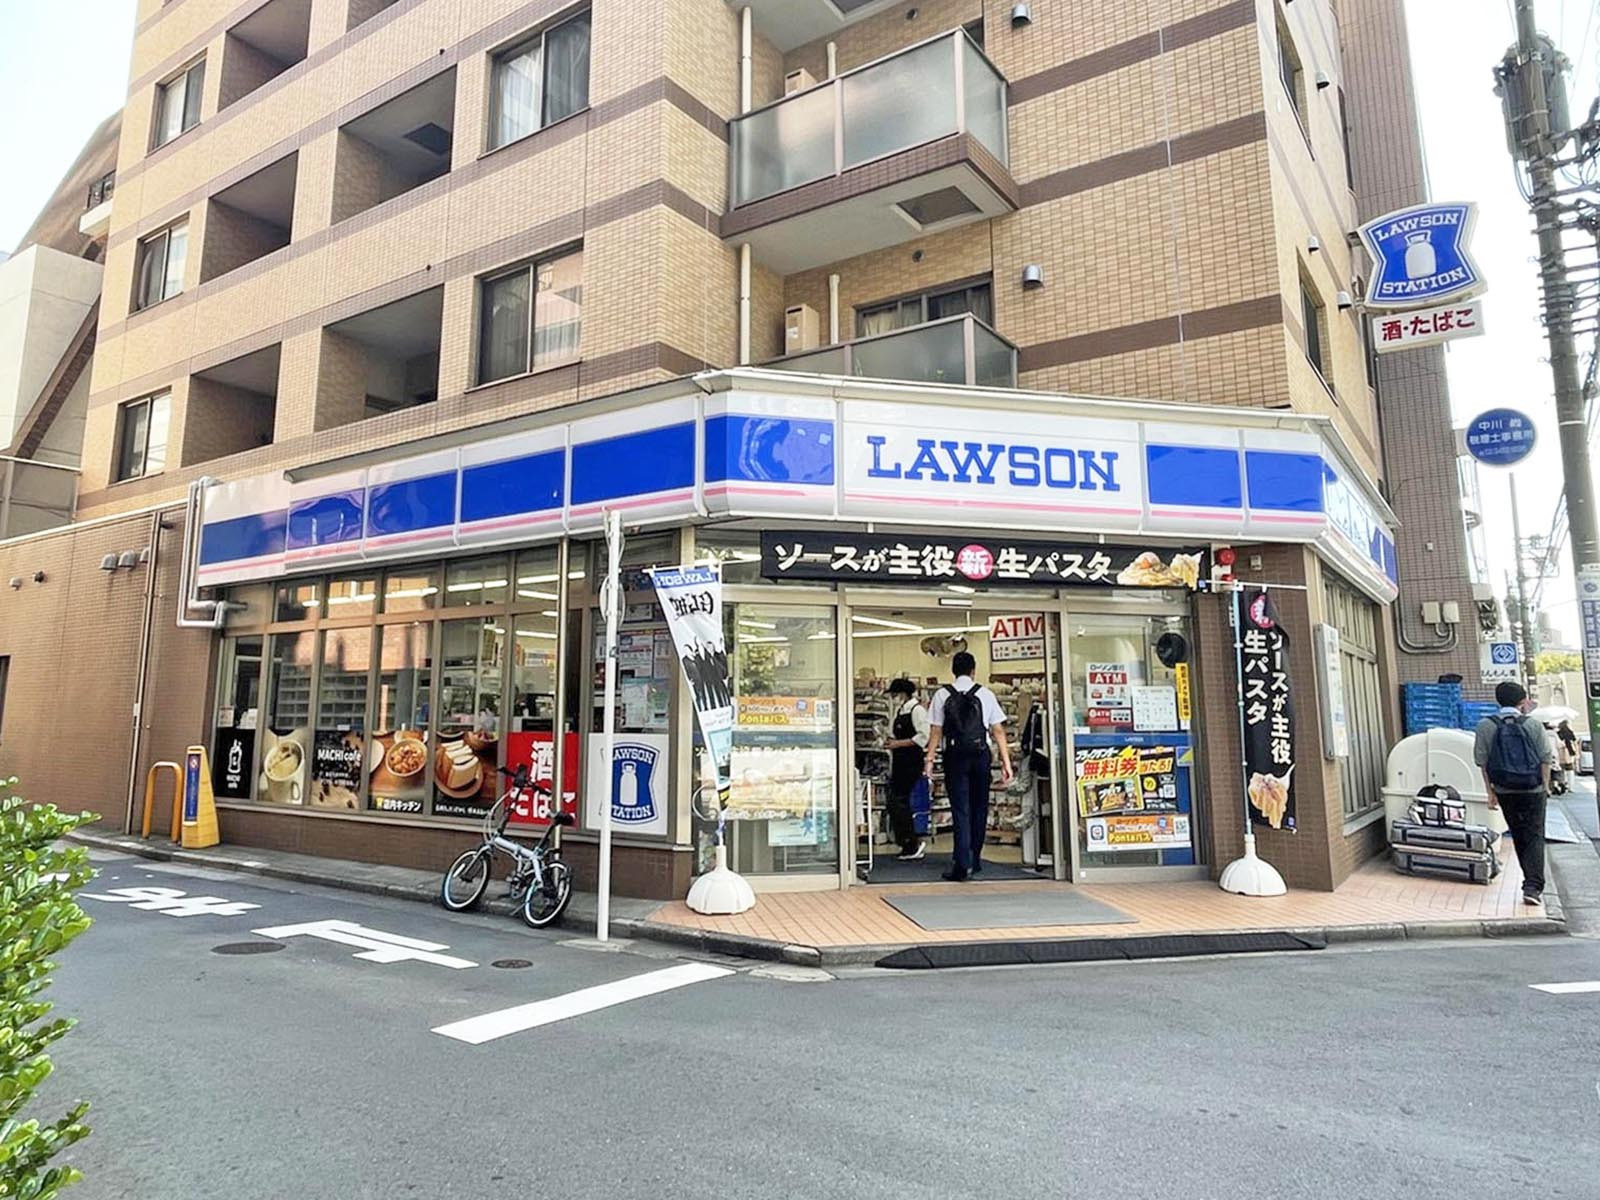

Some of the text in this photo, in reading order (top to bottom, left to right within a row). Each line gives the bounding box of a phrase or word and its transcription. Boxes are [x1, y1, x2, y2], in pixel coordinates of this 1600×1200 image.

[1375, 213, 1459, 241] LAWSON
[1381, 267, 1466, 295] STATION
[1381, 308, 1476, 341] 酒・たばこ
[866, 436, 1120, 492] LAWSON
[992, 616, 1045, 638] ATM
[1095, 673, 1123, 683] ATM
[1244, 629, 1269, 725] 生パスタ
[613, 748, 654, 765] AWSON
[612, 804, 653, 819] TATION
